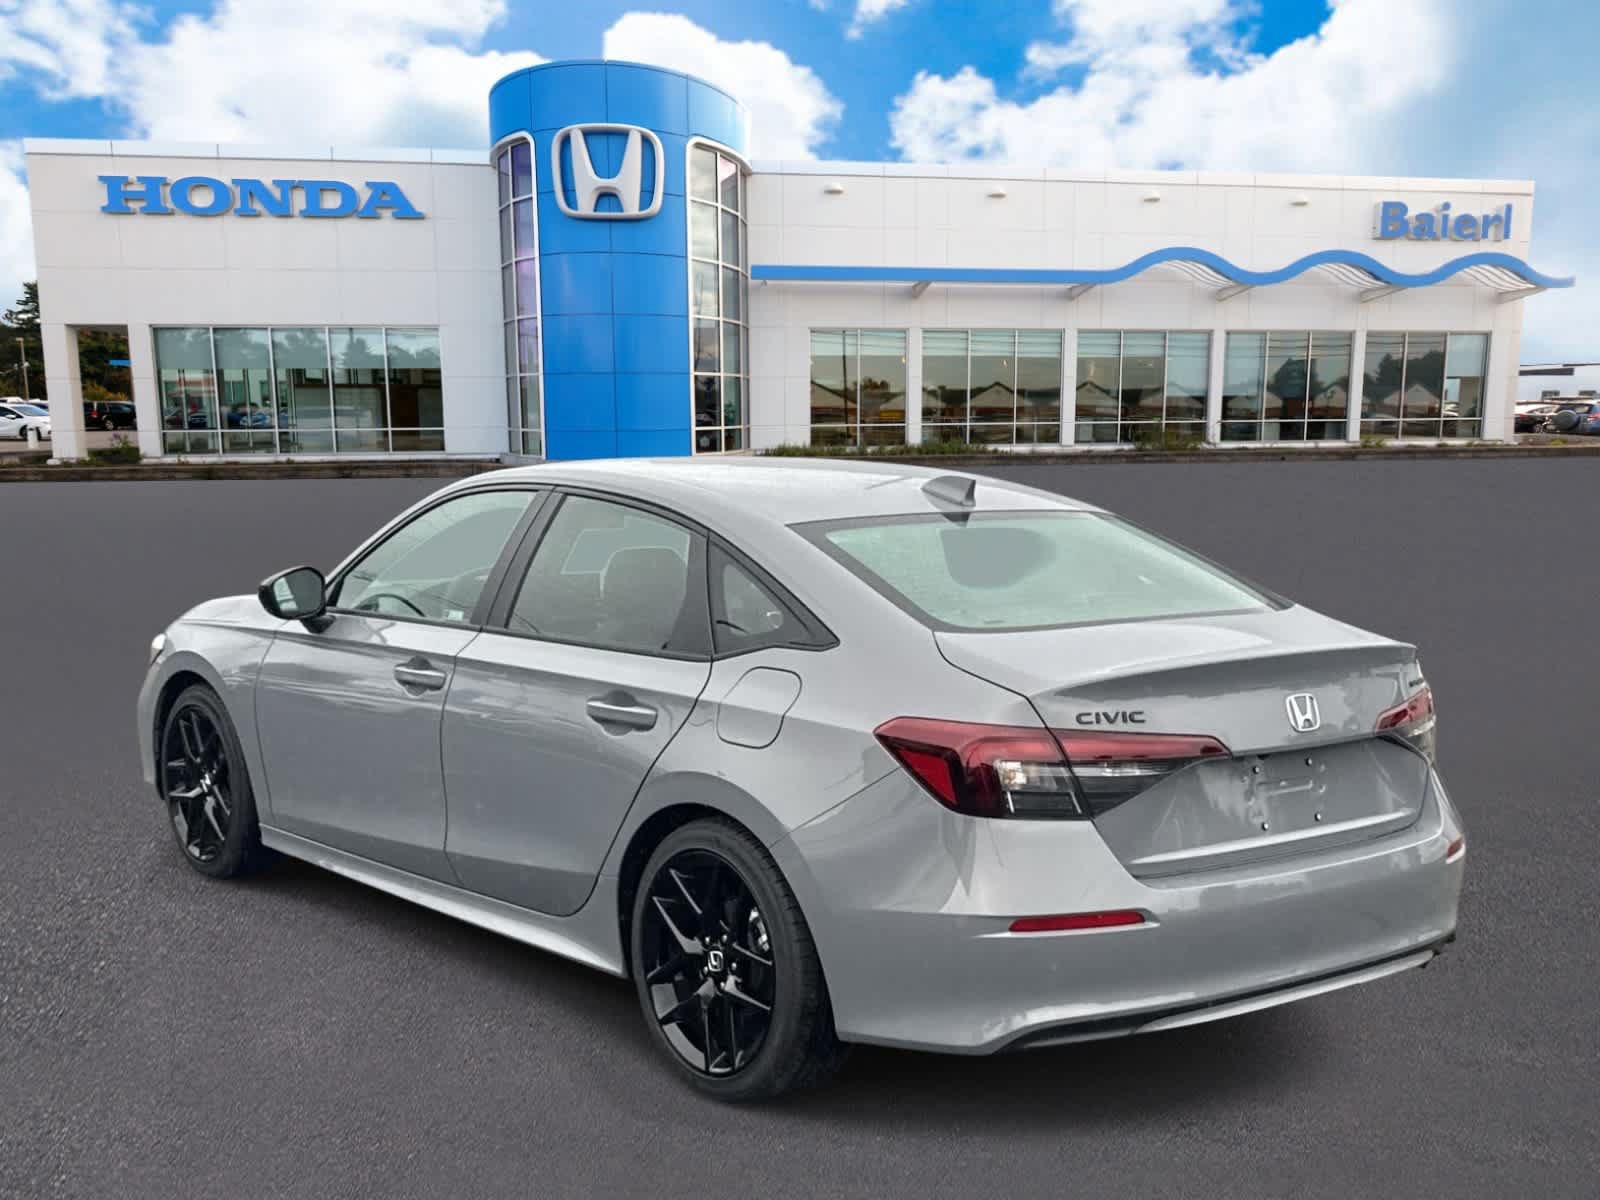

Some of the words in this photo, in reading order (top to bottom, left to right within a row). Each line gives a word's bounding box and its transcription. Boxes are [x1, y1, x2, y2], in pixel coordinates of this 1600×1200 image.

[97, 175, 426, 219] HONDA
[1378, 201, 1513, 240] Baierl
[1075, 710, 1147, 725] CIVIC
